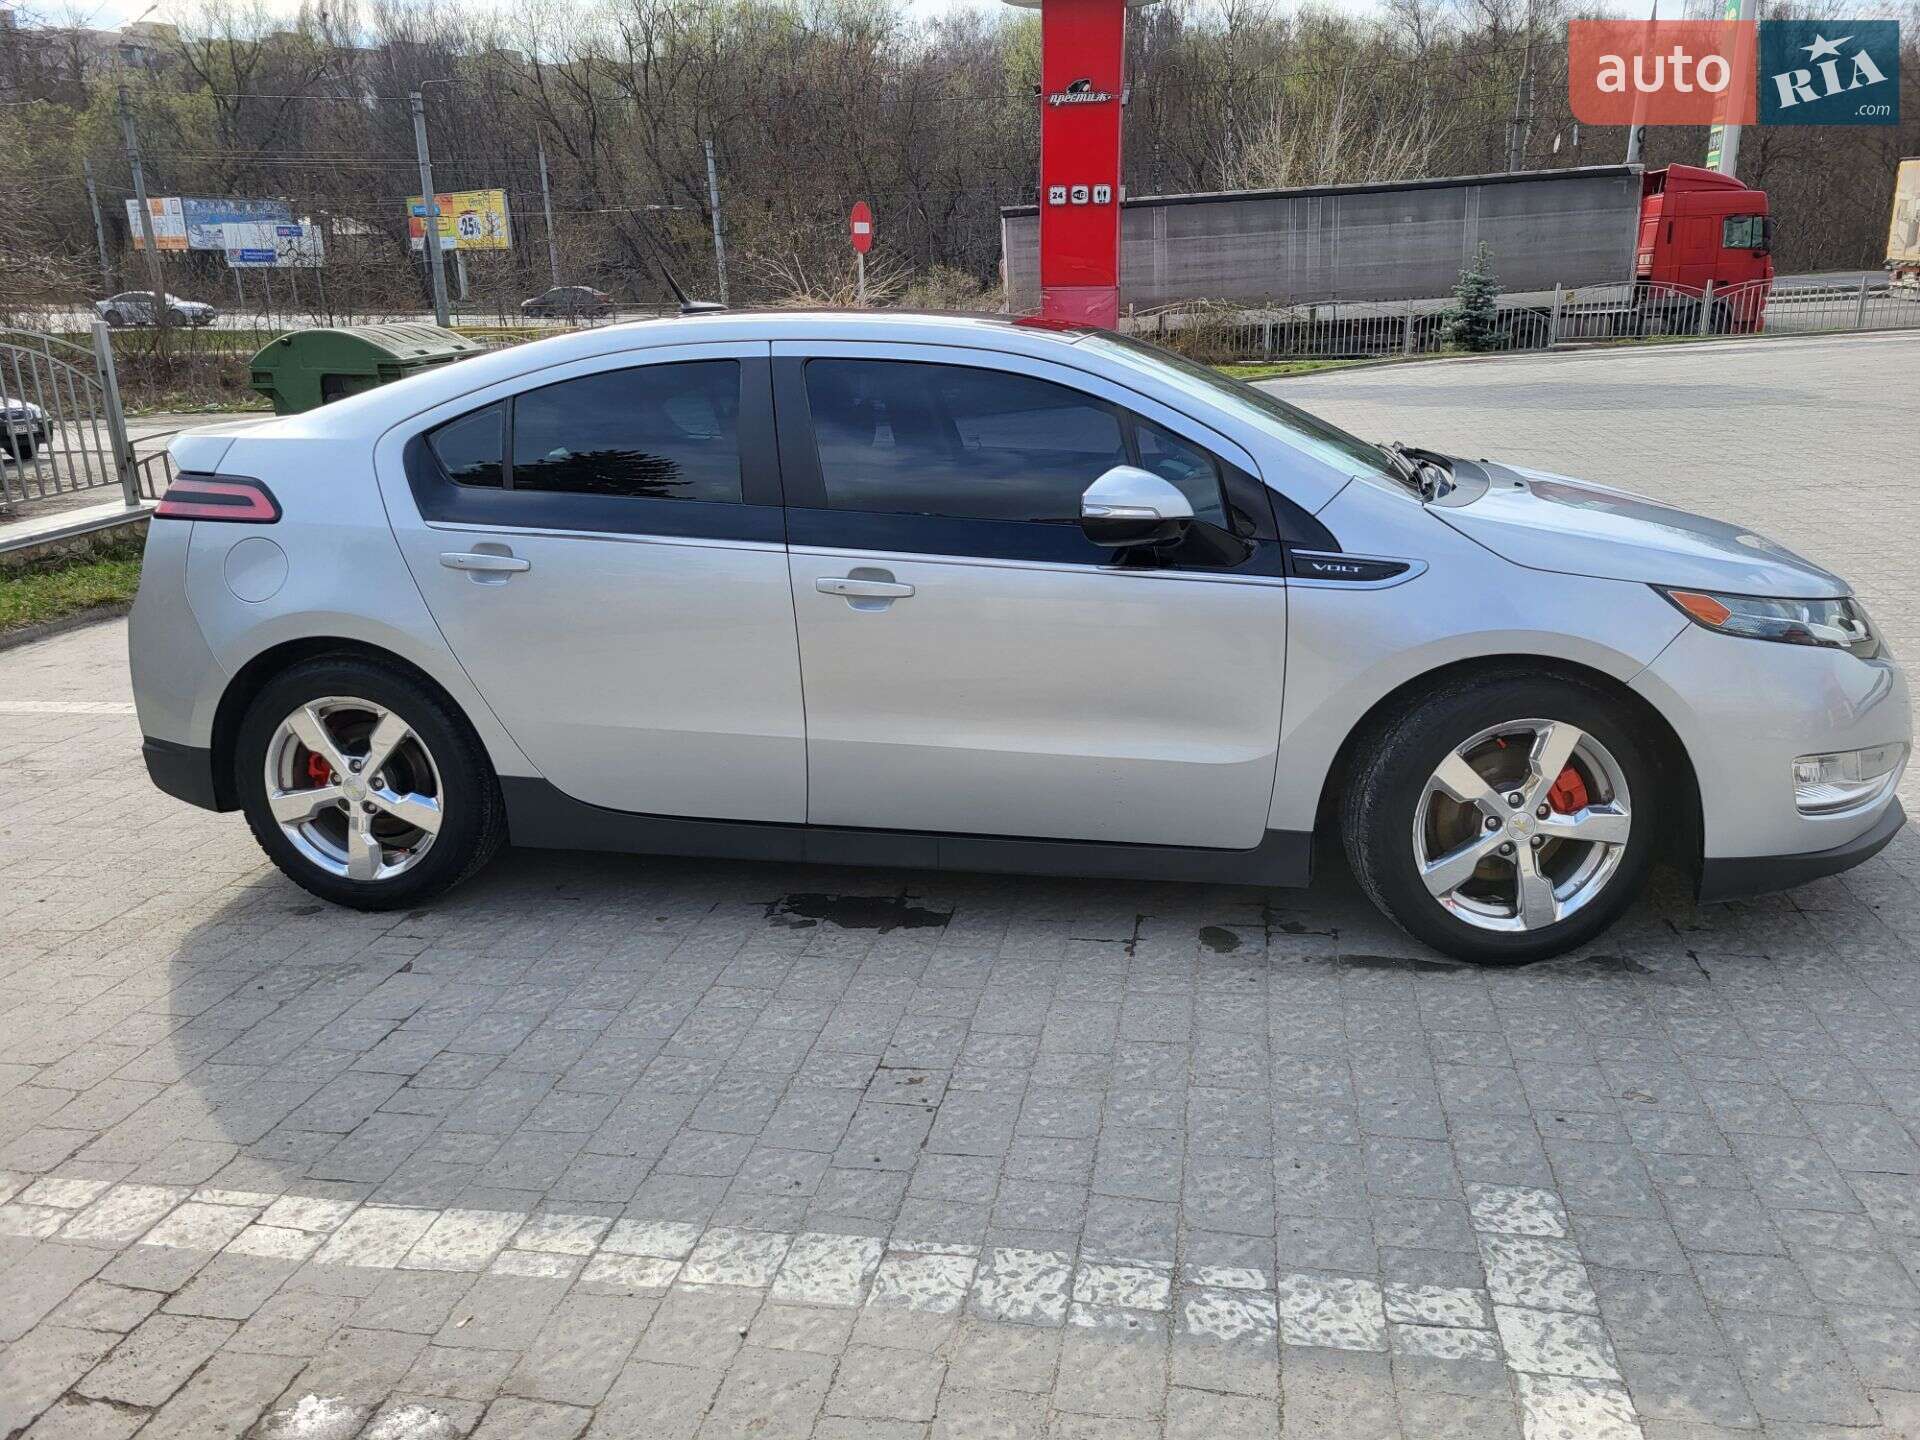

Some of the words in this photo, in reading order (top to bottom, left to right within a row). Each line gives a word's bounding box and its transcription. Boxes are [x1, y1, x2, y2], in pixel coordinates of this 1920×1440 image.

[1052, 191, 1063, 199] 24
[460, 216, 481, 236] -25%
[1312, 563, 1363, 573] VOLT
